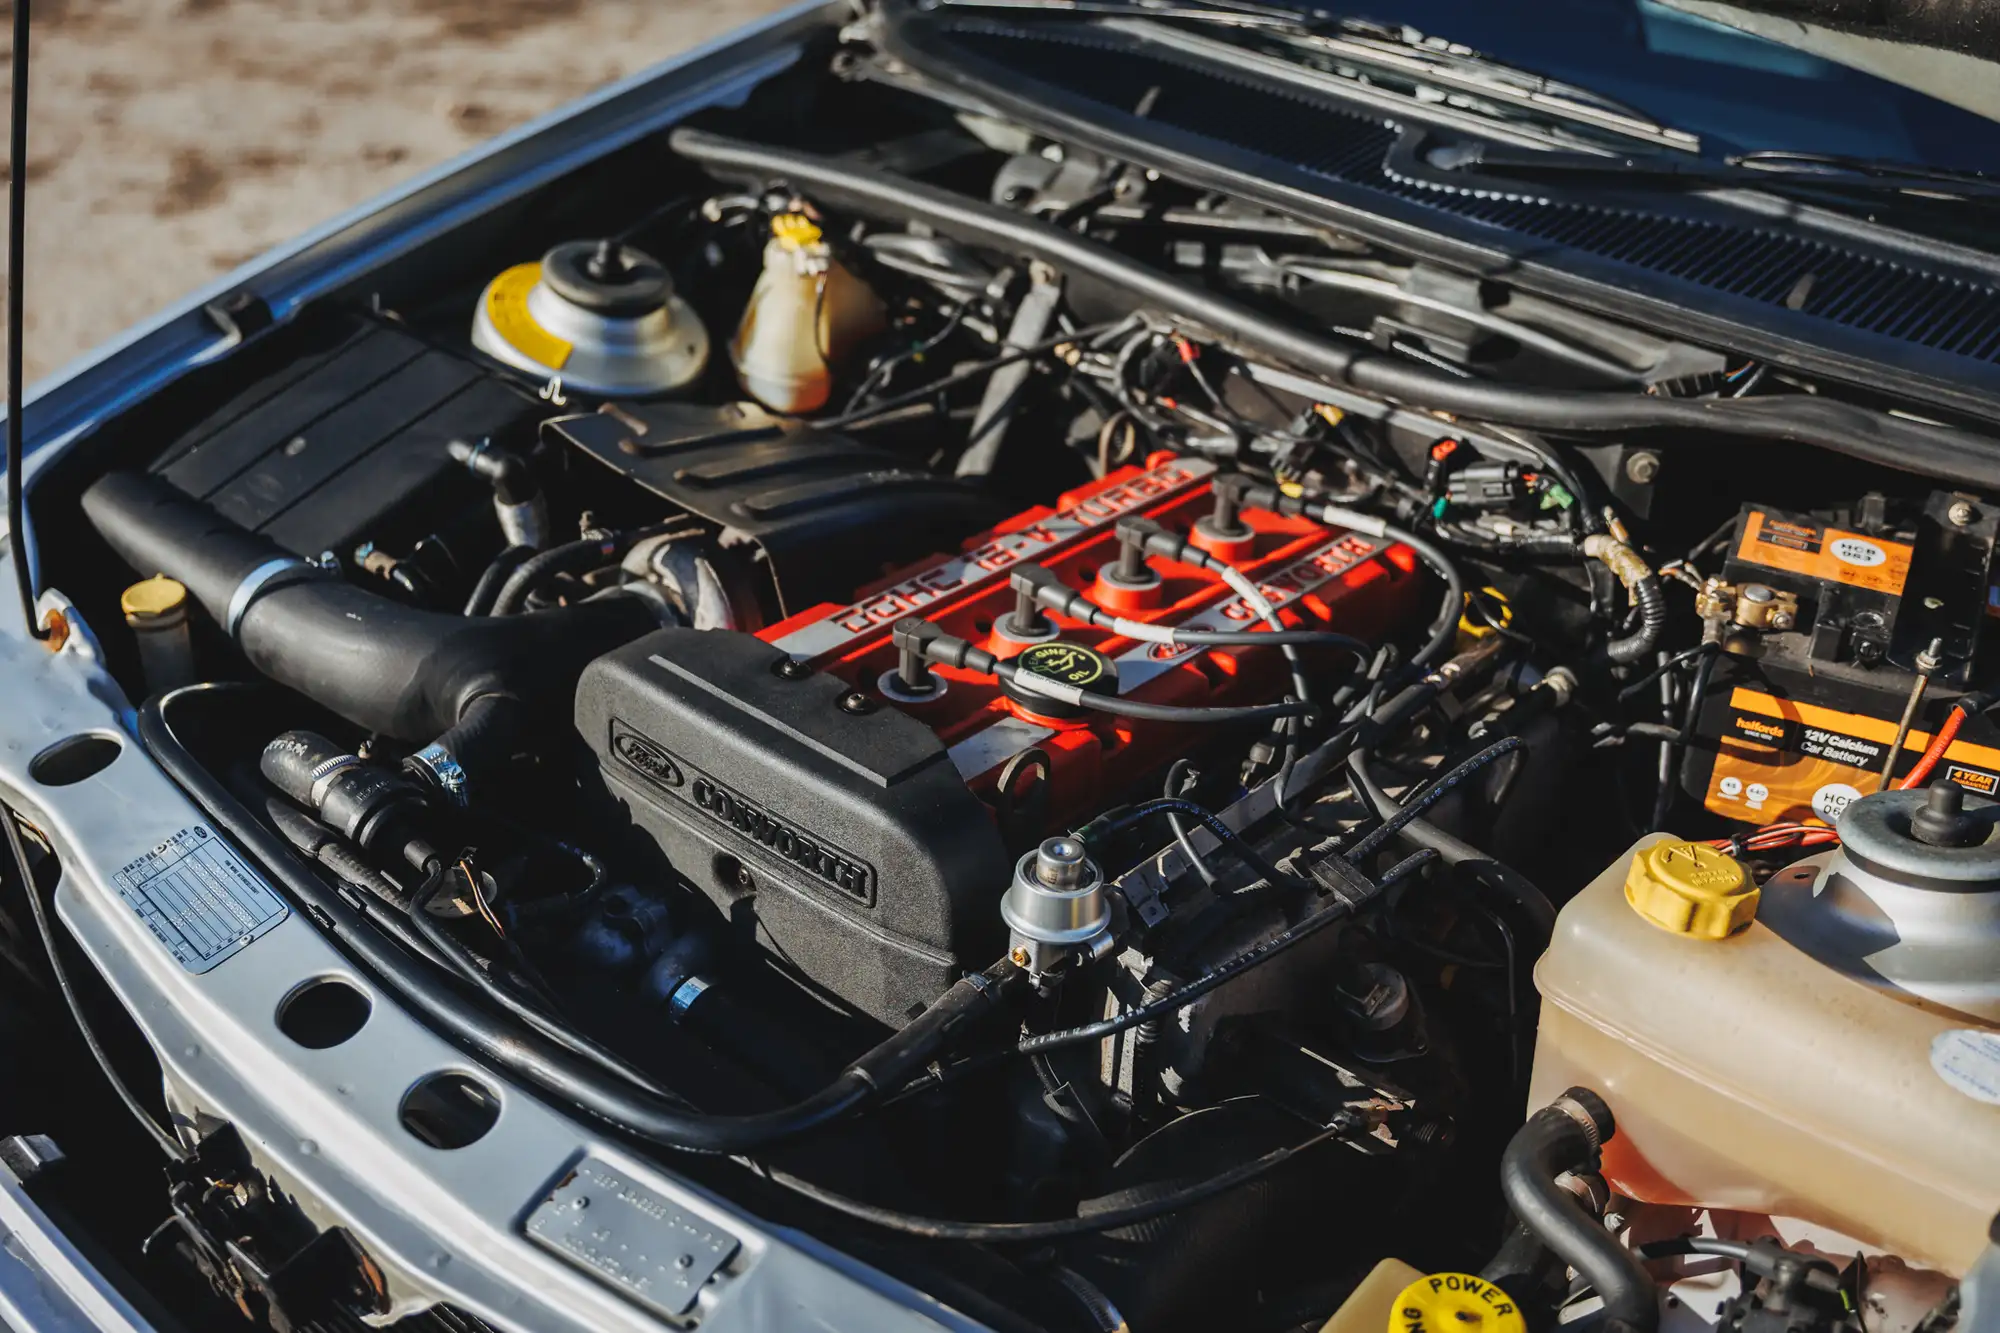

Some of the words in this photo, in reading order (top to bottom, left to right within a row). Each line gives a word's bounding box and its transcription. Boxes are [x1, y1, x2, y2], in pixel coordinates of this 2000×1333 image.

[829, 567, 968, 633] DOHC
[1057, 465, 1195, 527] TURBO
[1029, 648, 1068, 665] ENGINE
[1068, 670, 1090, 681] OIL
[1736, 717, 1785, 738] halfords
[1801, 741, 1821, 756] Car
[1822, 746, 1869, 767] Battery
[1804, 729, 1831, 743] 12V
[1829, 734, 1879, 757] Calcium
[1963, 771, 1993, 785] YEAR
[627, 741, 671, 780] Ford
[692, 776, 868, 898] COSWORTH
[1428, 1275, 1513, 1317] POWER
